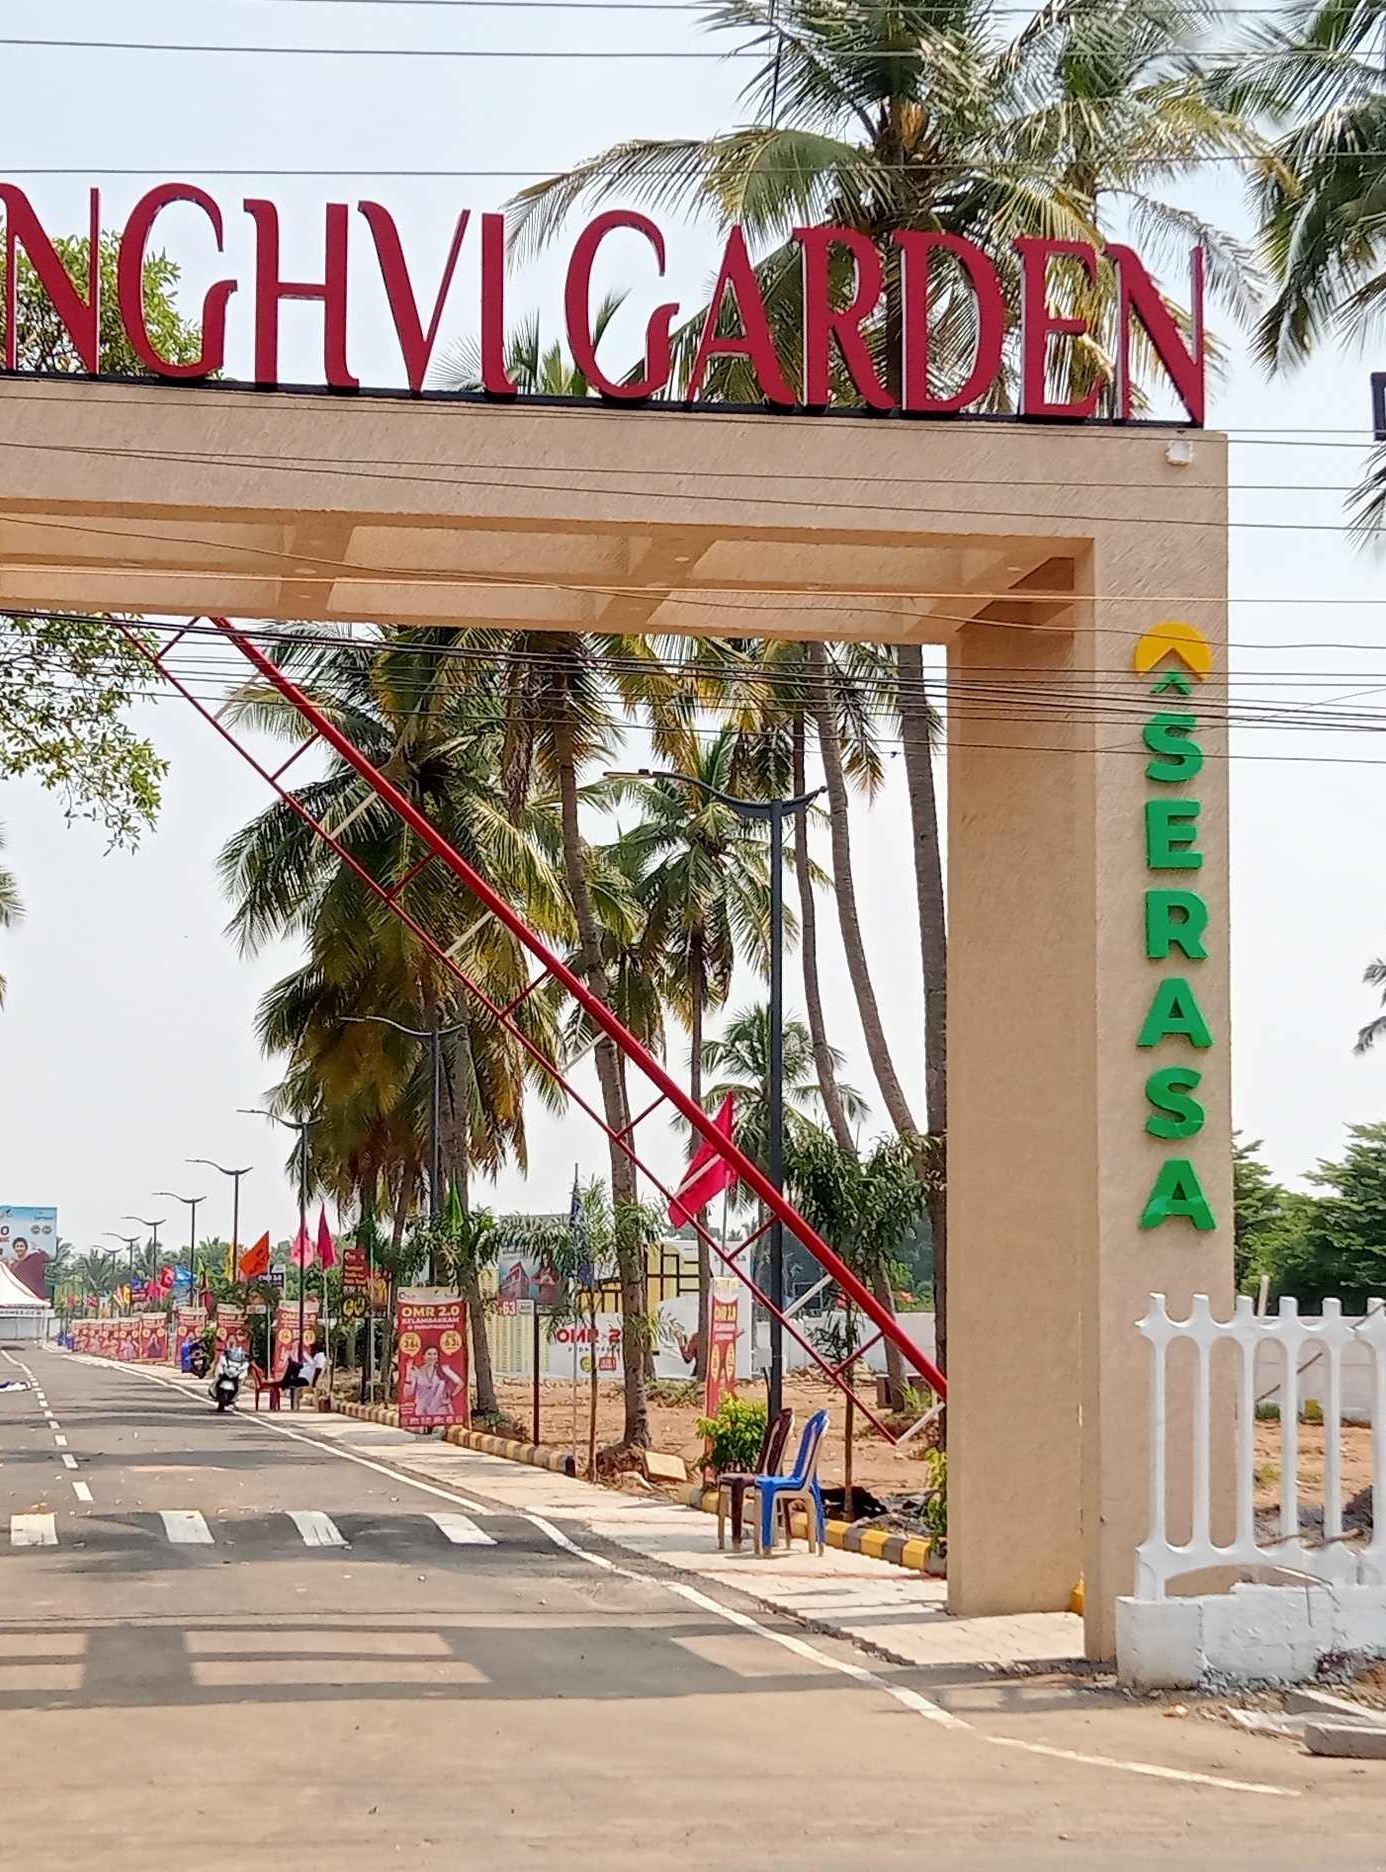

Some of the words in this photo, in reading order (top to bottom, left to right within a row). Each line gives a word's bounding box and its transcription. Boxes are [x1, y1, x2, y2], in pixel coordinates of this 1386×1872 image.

[565, 208, 1205, 428] GARDEN
[1136, 710, 1217, 1231] SERASA
[401, 1306, 435, 1318] OMR
[437, 1305, 461, 1317] 2.0
